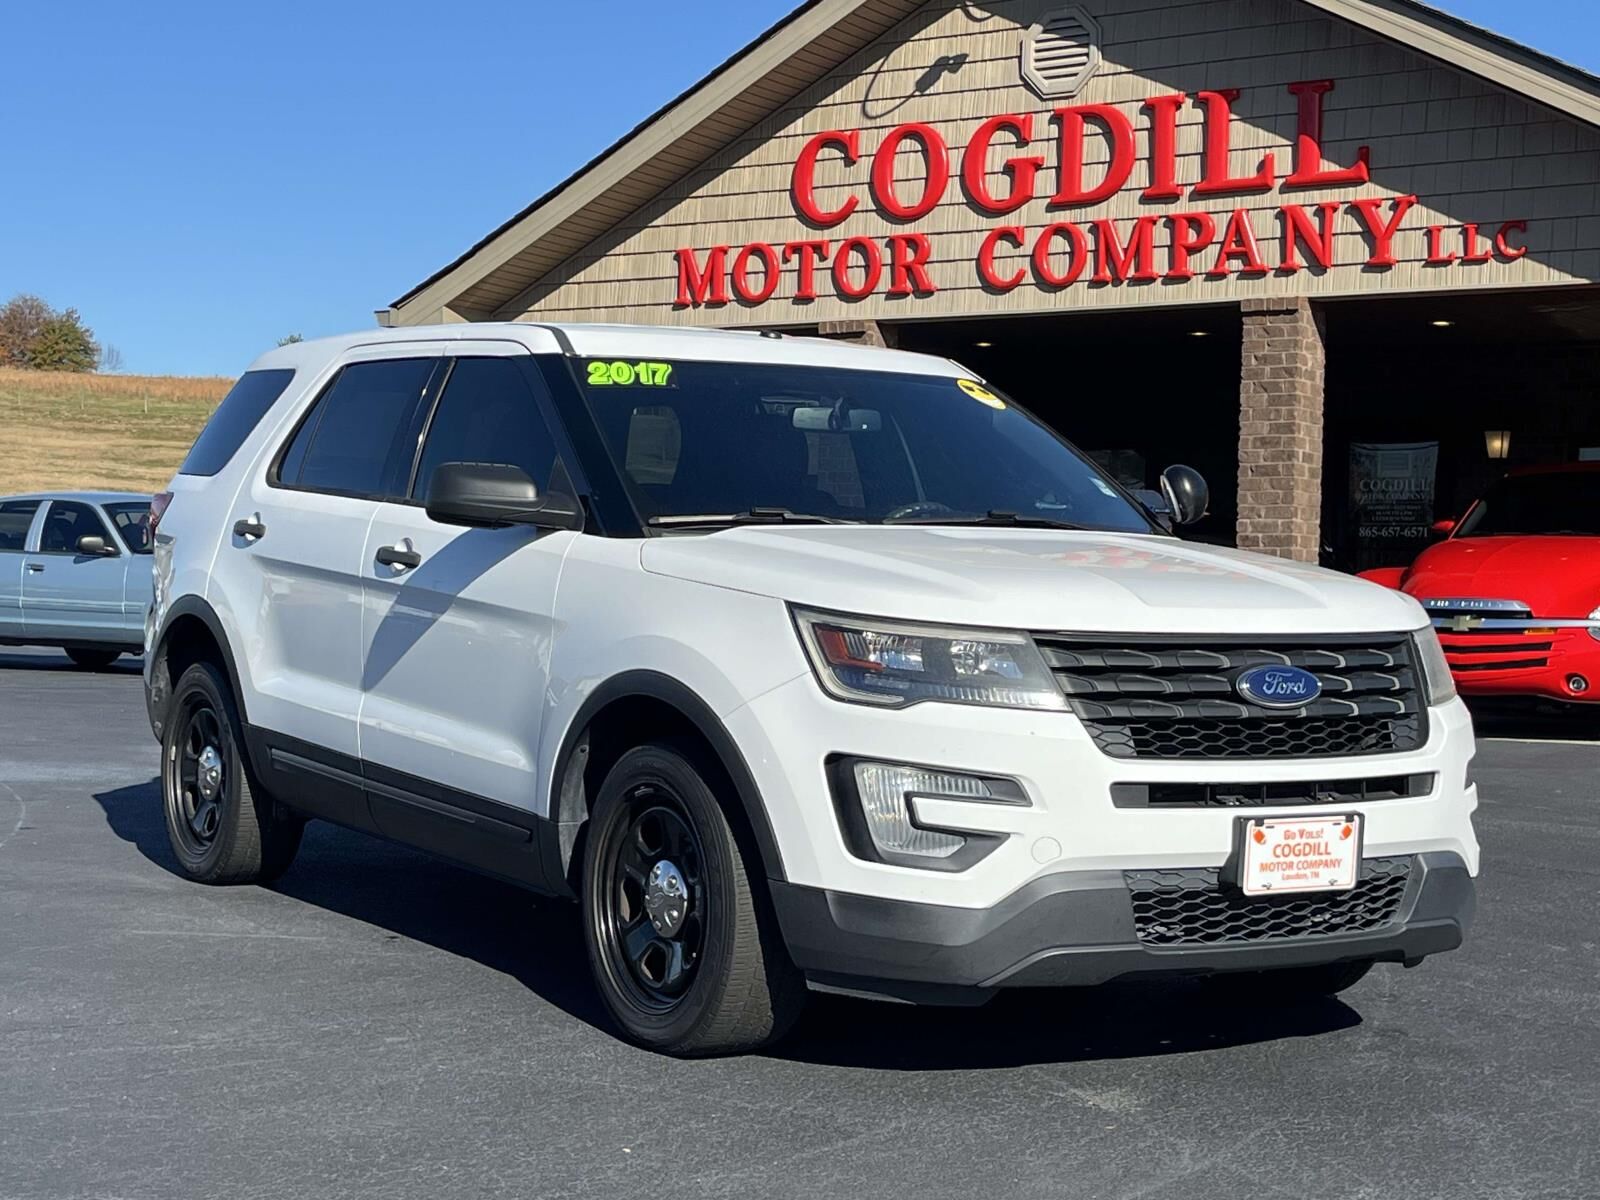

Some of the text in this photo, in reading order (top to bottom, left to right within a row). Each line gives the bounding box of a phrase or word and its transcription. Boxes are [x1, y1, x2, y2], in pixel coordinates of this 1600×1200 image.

[793, 79, 1370, 226] COGDILL
[675, 194, 1528, 306] MOTOR COMPANY LLC
[587, 362, 672, 386] 2017
[1359, 479, 1430, 492] COGDILL
[1358, 526, 1429, 538] 865-657-6571
[1262, 671, 1307, 694] Ford
[1273, 842, 1332, 858] COGDILL
[1259, 858, 1342, 873] MOTOR COMPANY
